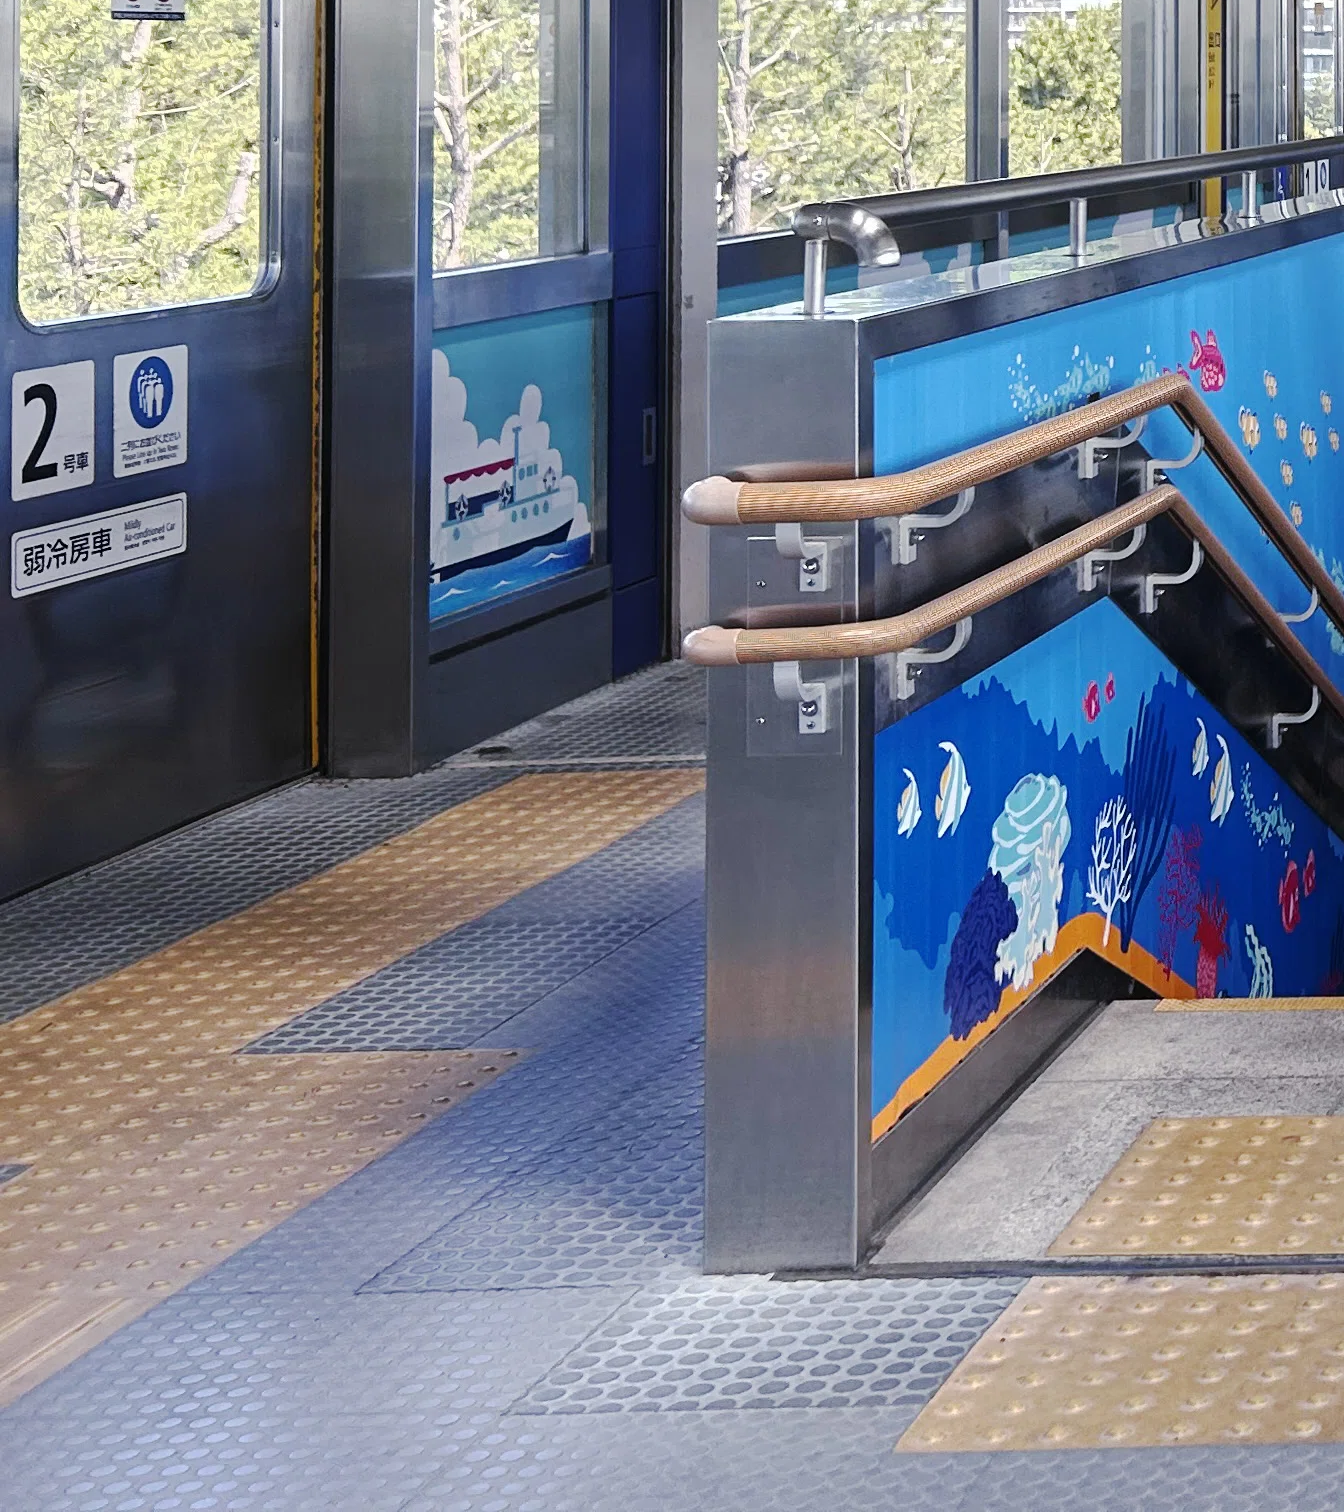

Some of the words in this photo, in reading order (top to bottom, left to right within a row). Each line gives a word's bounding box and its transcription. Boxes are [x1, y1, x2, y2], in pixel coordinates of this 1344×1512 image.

[22, 383, 58, 484] 2
[63, 451, 89, 473] 号車
[23, 528, 112, 577] 弱冷房車
